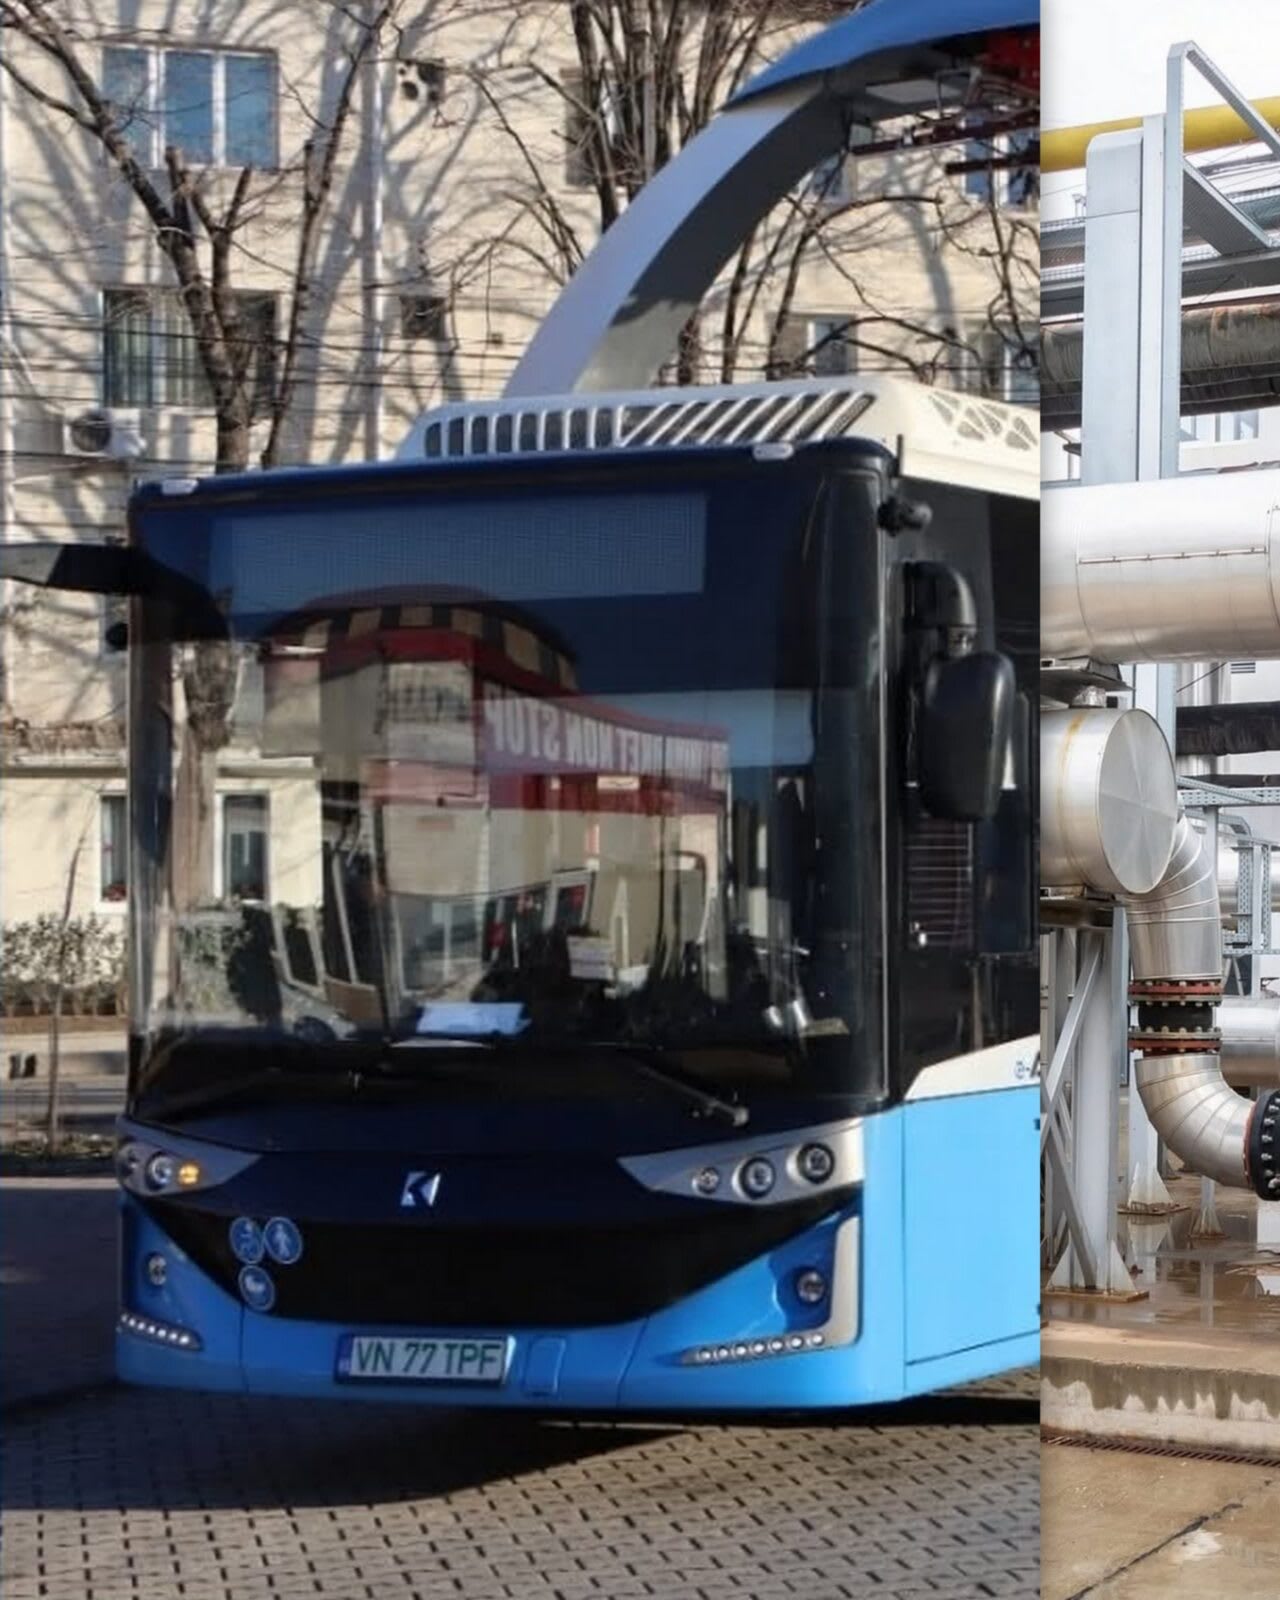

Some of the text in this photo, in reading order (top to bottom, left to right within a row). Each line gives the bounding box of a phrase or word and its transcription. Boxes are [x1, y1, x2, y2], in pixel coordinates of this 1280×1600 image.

[357, 1341, 502, 1375] VN 77 TPF
